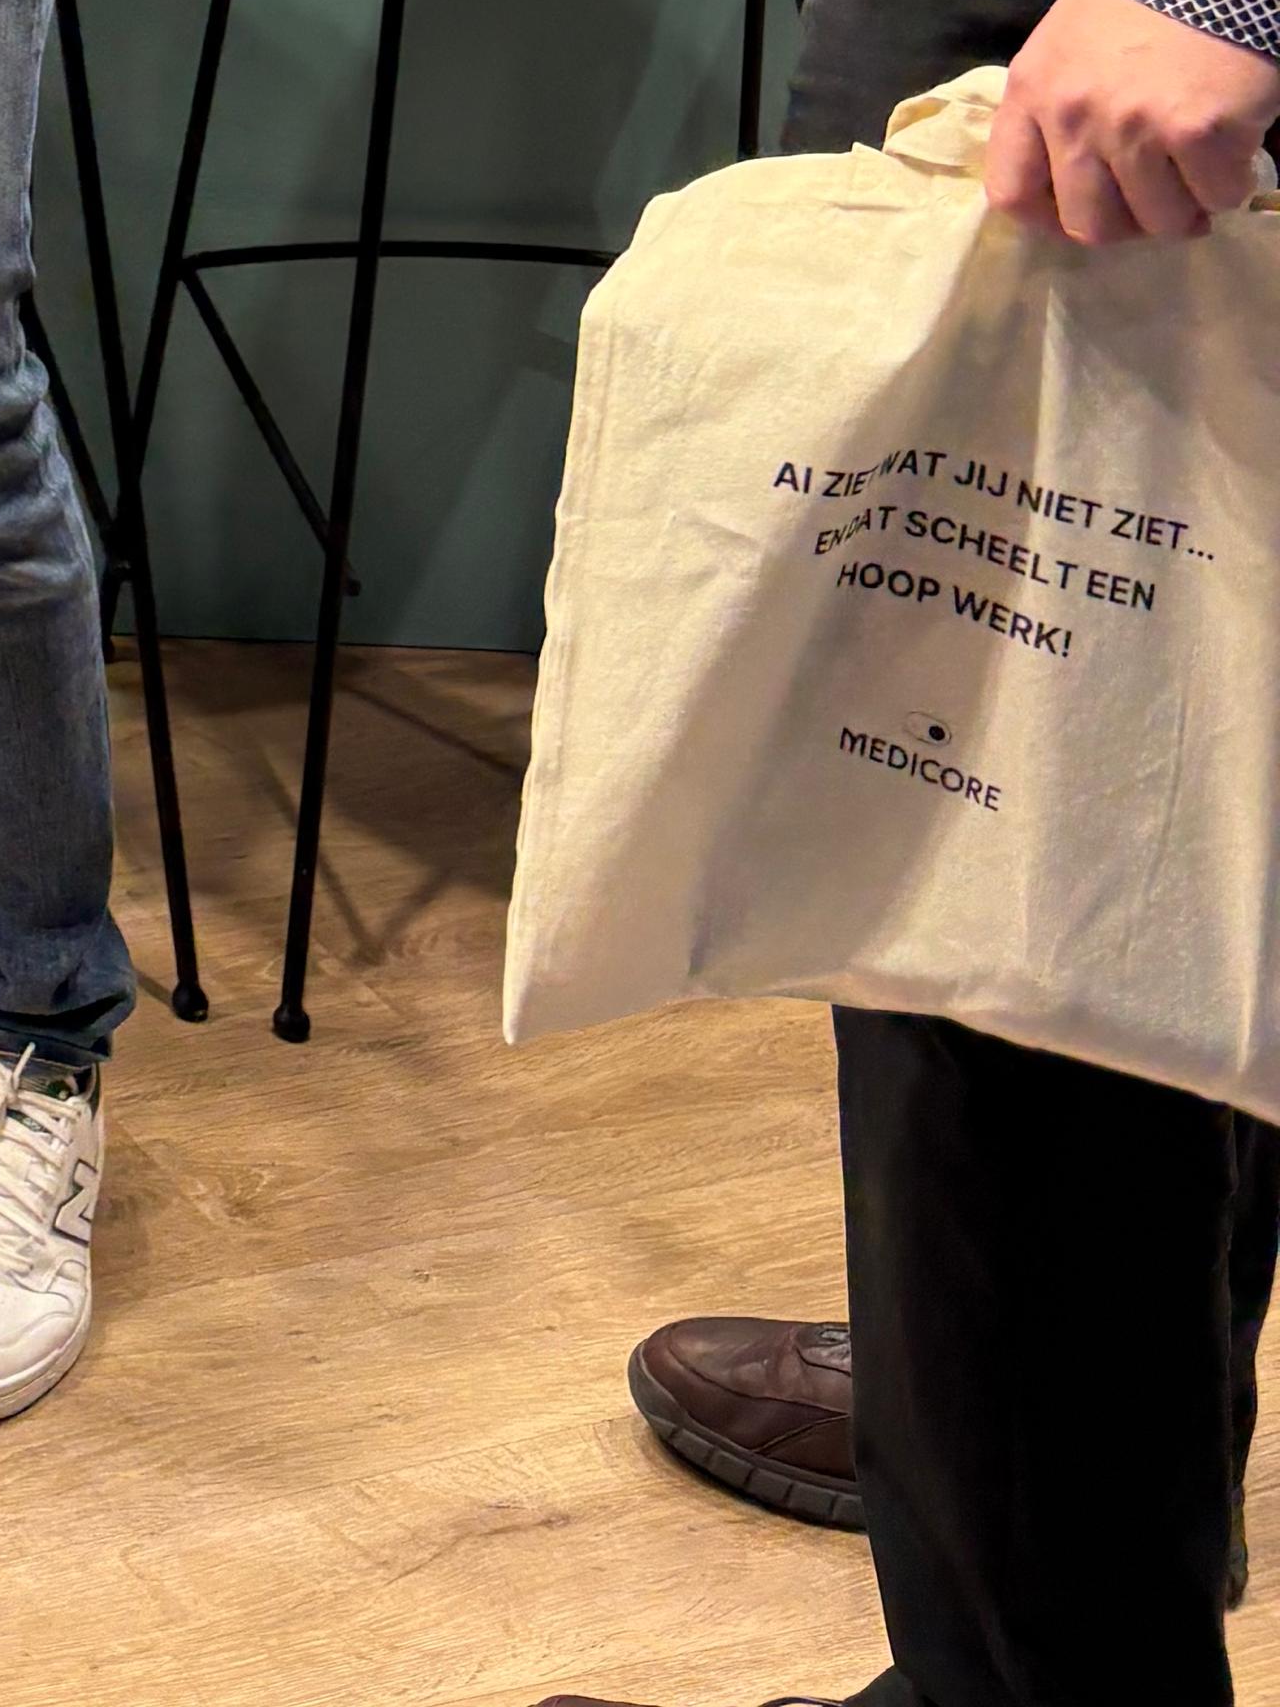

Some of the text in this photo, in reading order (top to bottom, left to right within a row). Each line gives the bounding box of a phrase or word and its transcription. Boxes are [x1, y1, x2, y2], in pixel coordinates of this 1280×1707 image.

[773, 461, 813, 495] AI
[954, 459, 1009, 498] JIJ
[1015, 479, 1104, 530] NIET
[1109, 508, 1216, 561] ZIET...
[814, 524, 848, 556] EN
[904, 510, 1078, 591] SCHEELT
[1085, 569, 1157, 613] EEN
[836, 561, 1074, 659] HOOP WERK!
[839, 726, 1003, 812] MEDICORE
